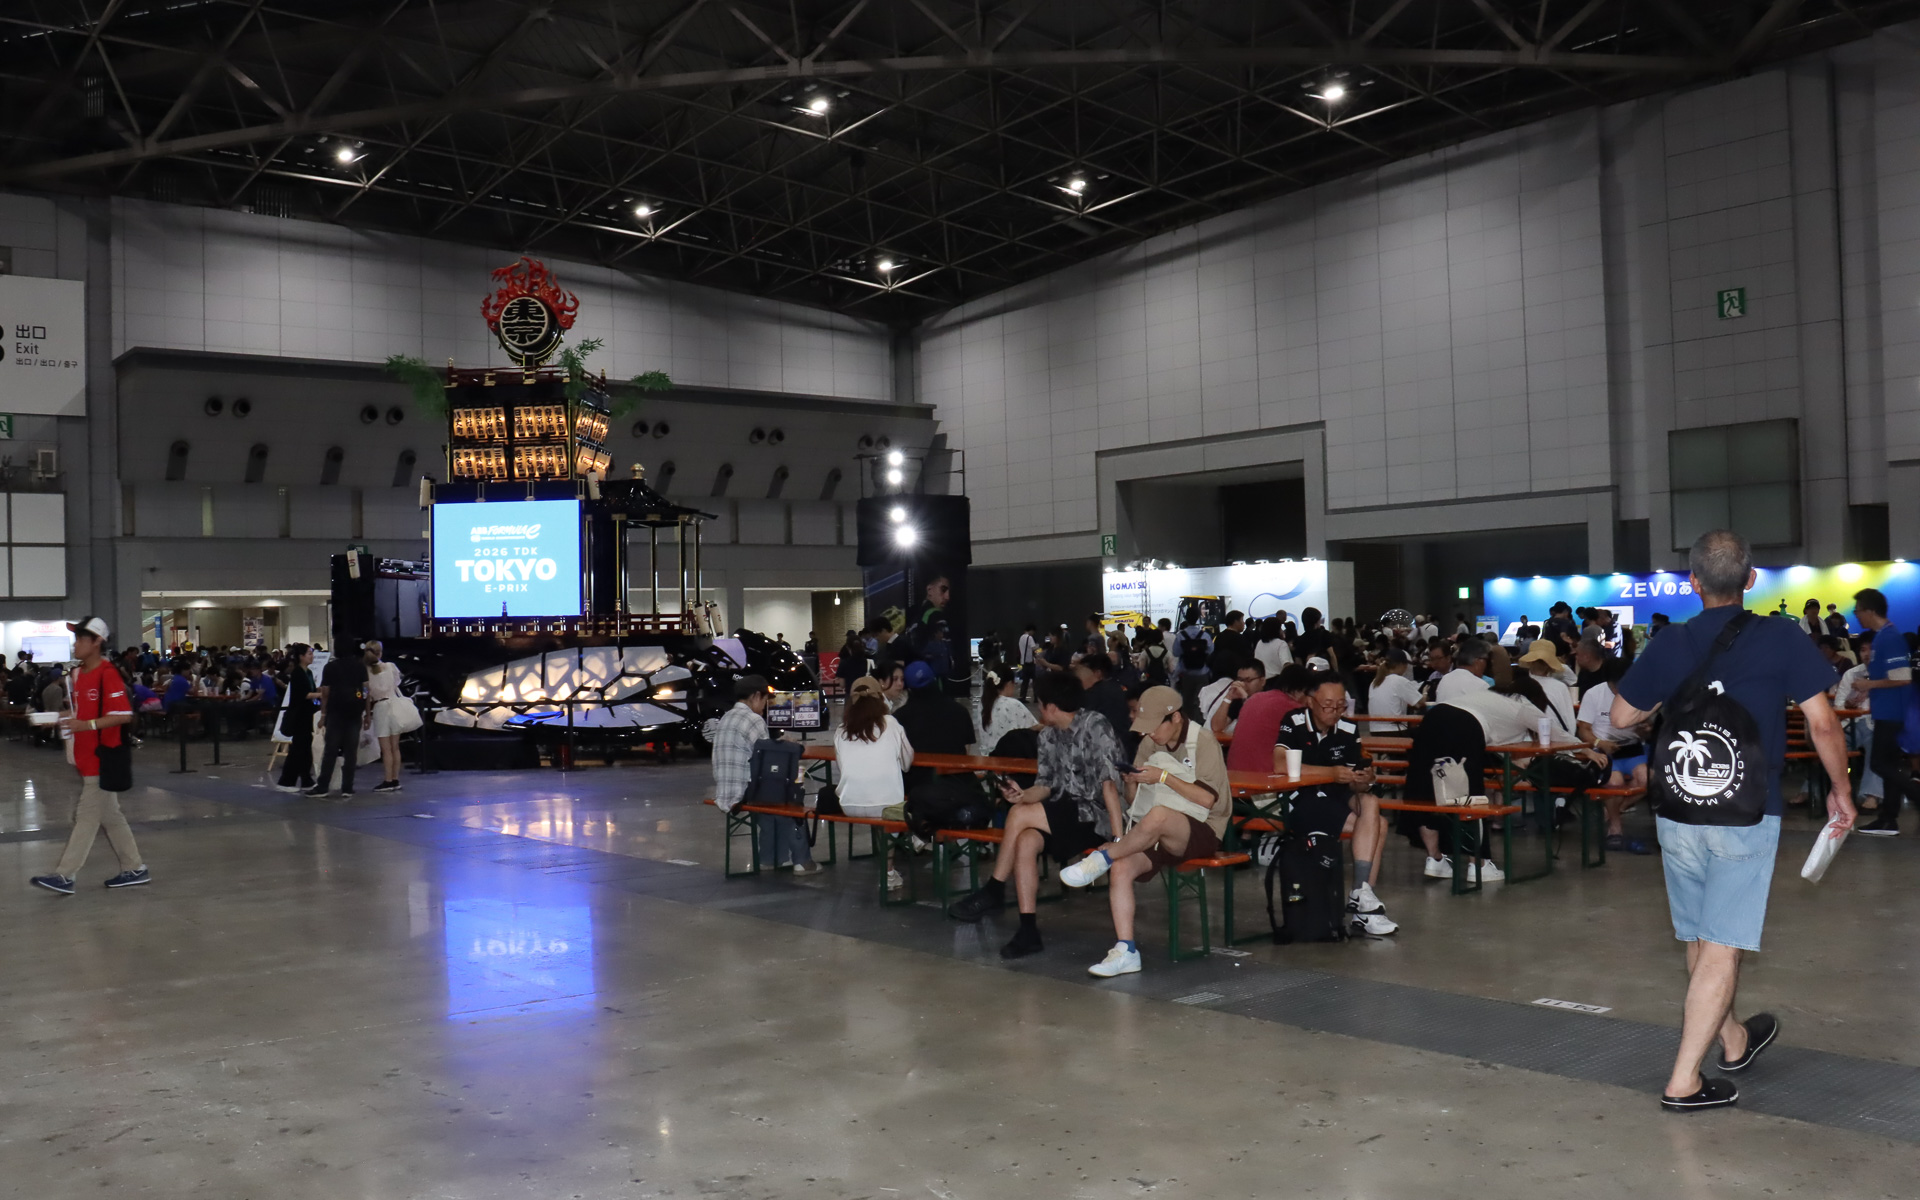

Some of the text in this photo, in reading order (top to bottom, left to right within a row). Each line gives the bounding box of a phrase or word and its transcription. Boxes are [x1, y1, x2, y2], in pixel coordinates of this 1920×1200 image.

[16, 324, 46, 339] 出口
[16, 342, 39, 354] Exit
[40, 359, 56, 367] 出口
[474, 547, 538, 556] 2026 TDK
[455, 558, 557, 582] TOKYO
[485, 584, 528, 592] E-PRIX
[1110, 581, 1147, 590] KOMATSU
[1620, 581, 1693, 598] ZEVのあ
[1664, 722, 1745, 806] CHIBA LOTTE MARINES
